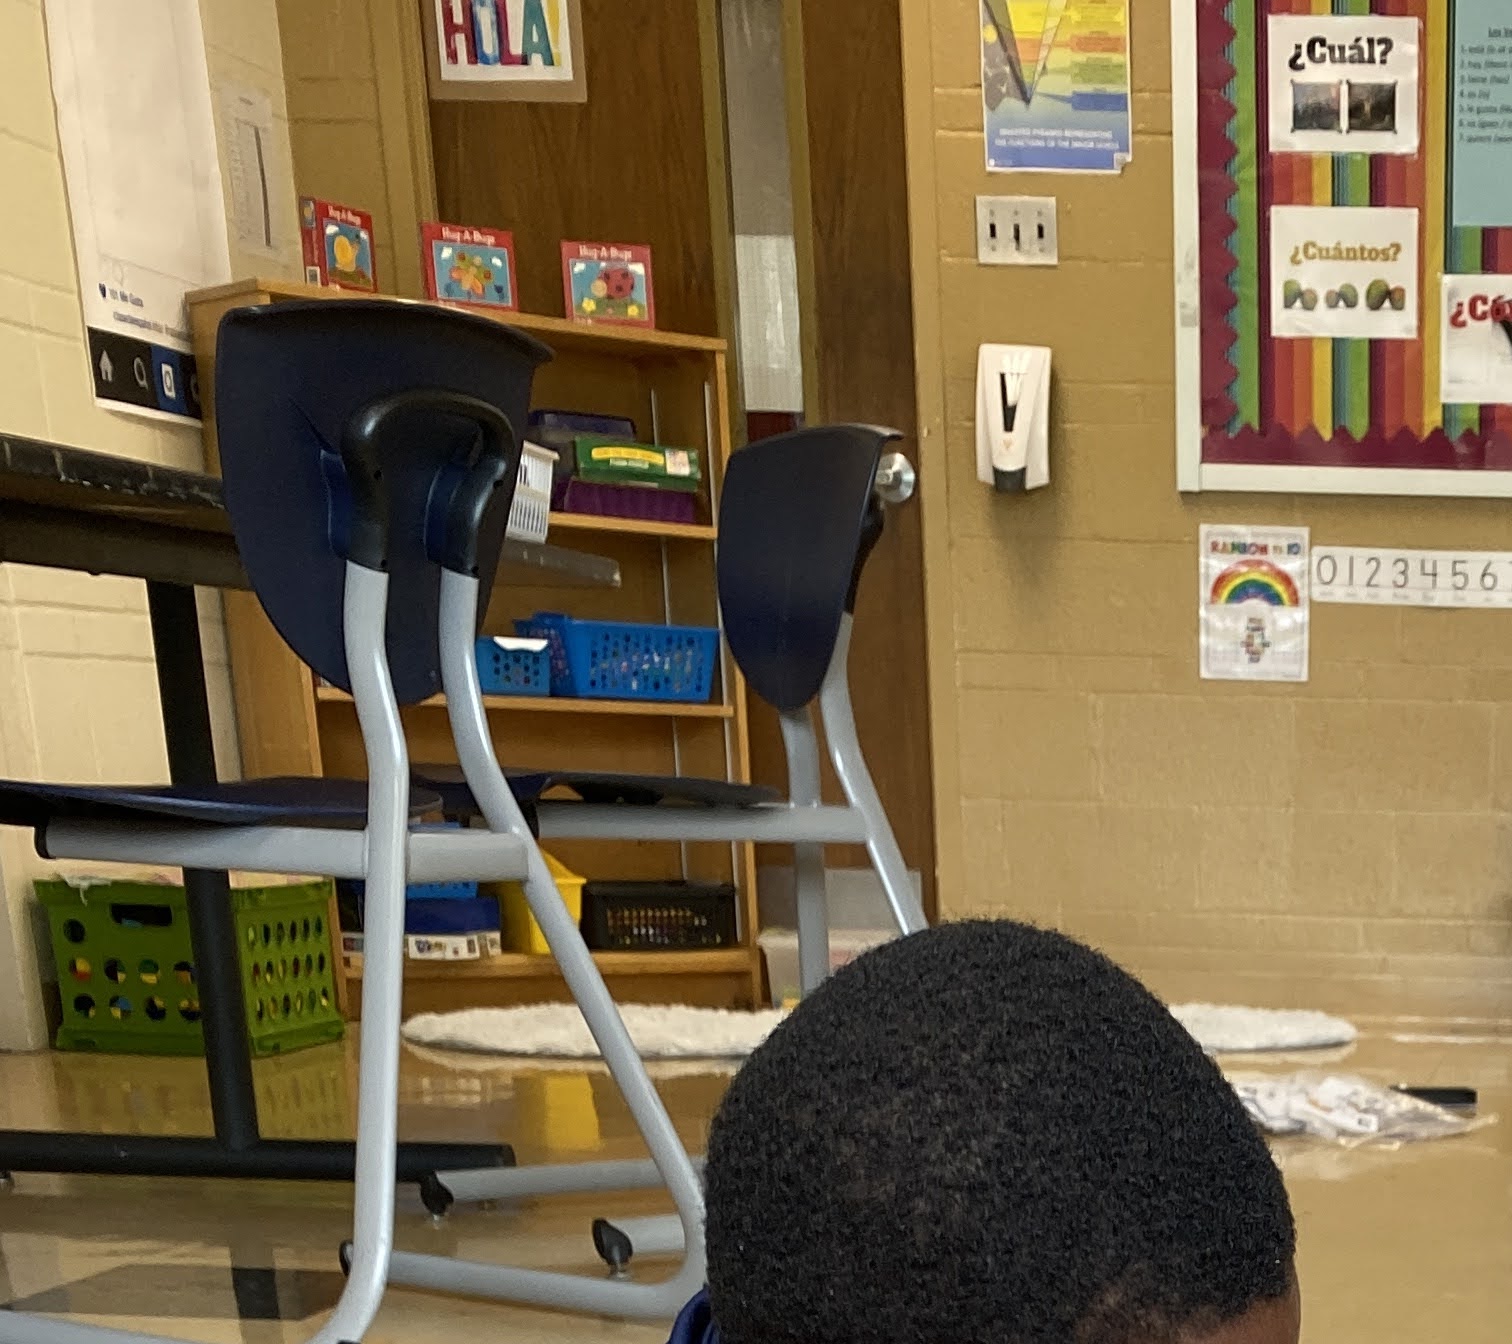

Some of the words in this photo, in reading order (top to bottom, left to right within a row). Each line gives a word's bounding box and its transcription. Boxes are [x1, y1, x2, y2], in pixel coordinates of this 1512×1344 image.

[1288, 36, 1394, 71] ¿Cuál?
[1290, 240, 1402, 265] ¿Cuántos?
[1316, 555, 1337, 585] 0
[1365, 557, 1381, 588] 2
[1392, 558, 1410, 589] 3
[1420, 559, 1438, 589] 4
[1451, 560, 1469, 590] 5
[1479, 561, 1498, 591] 6
